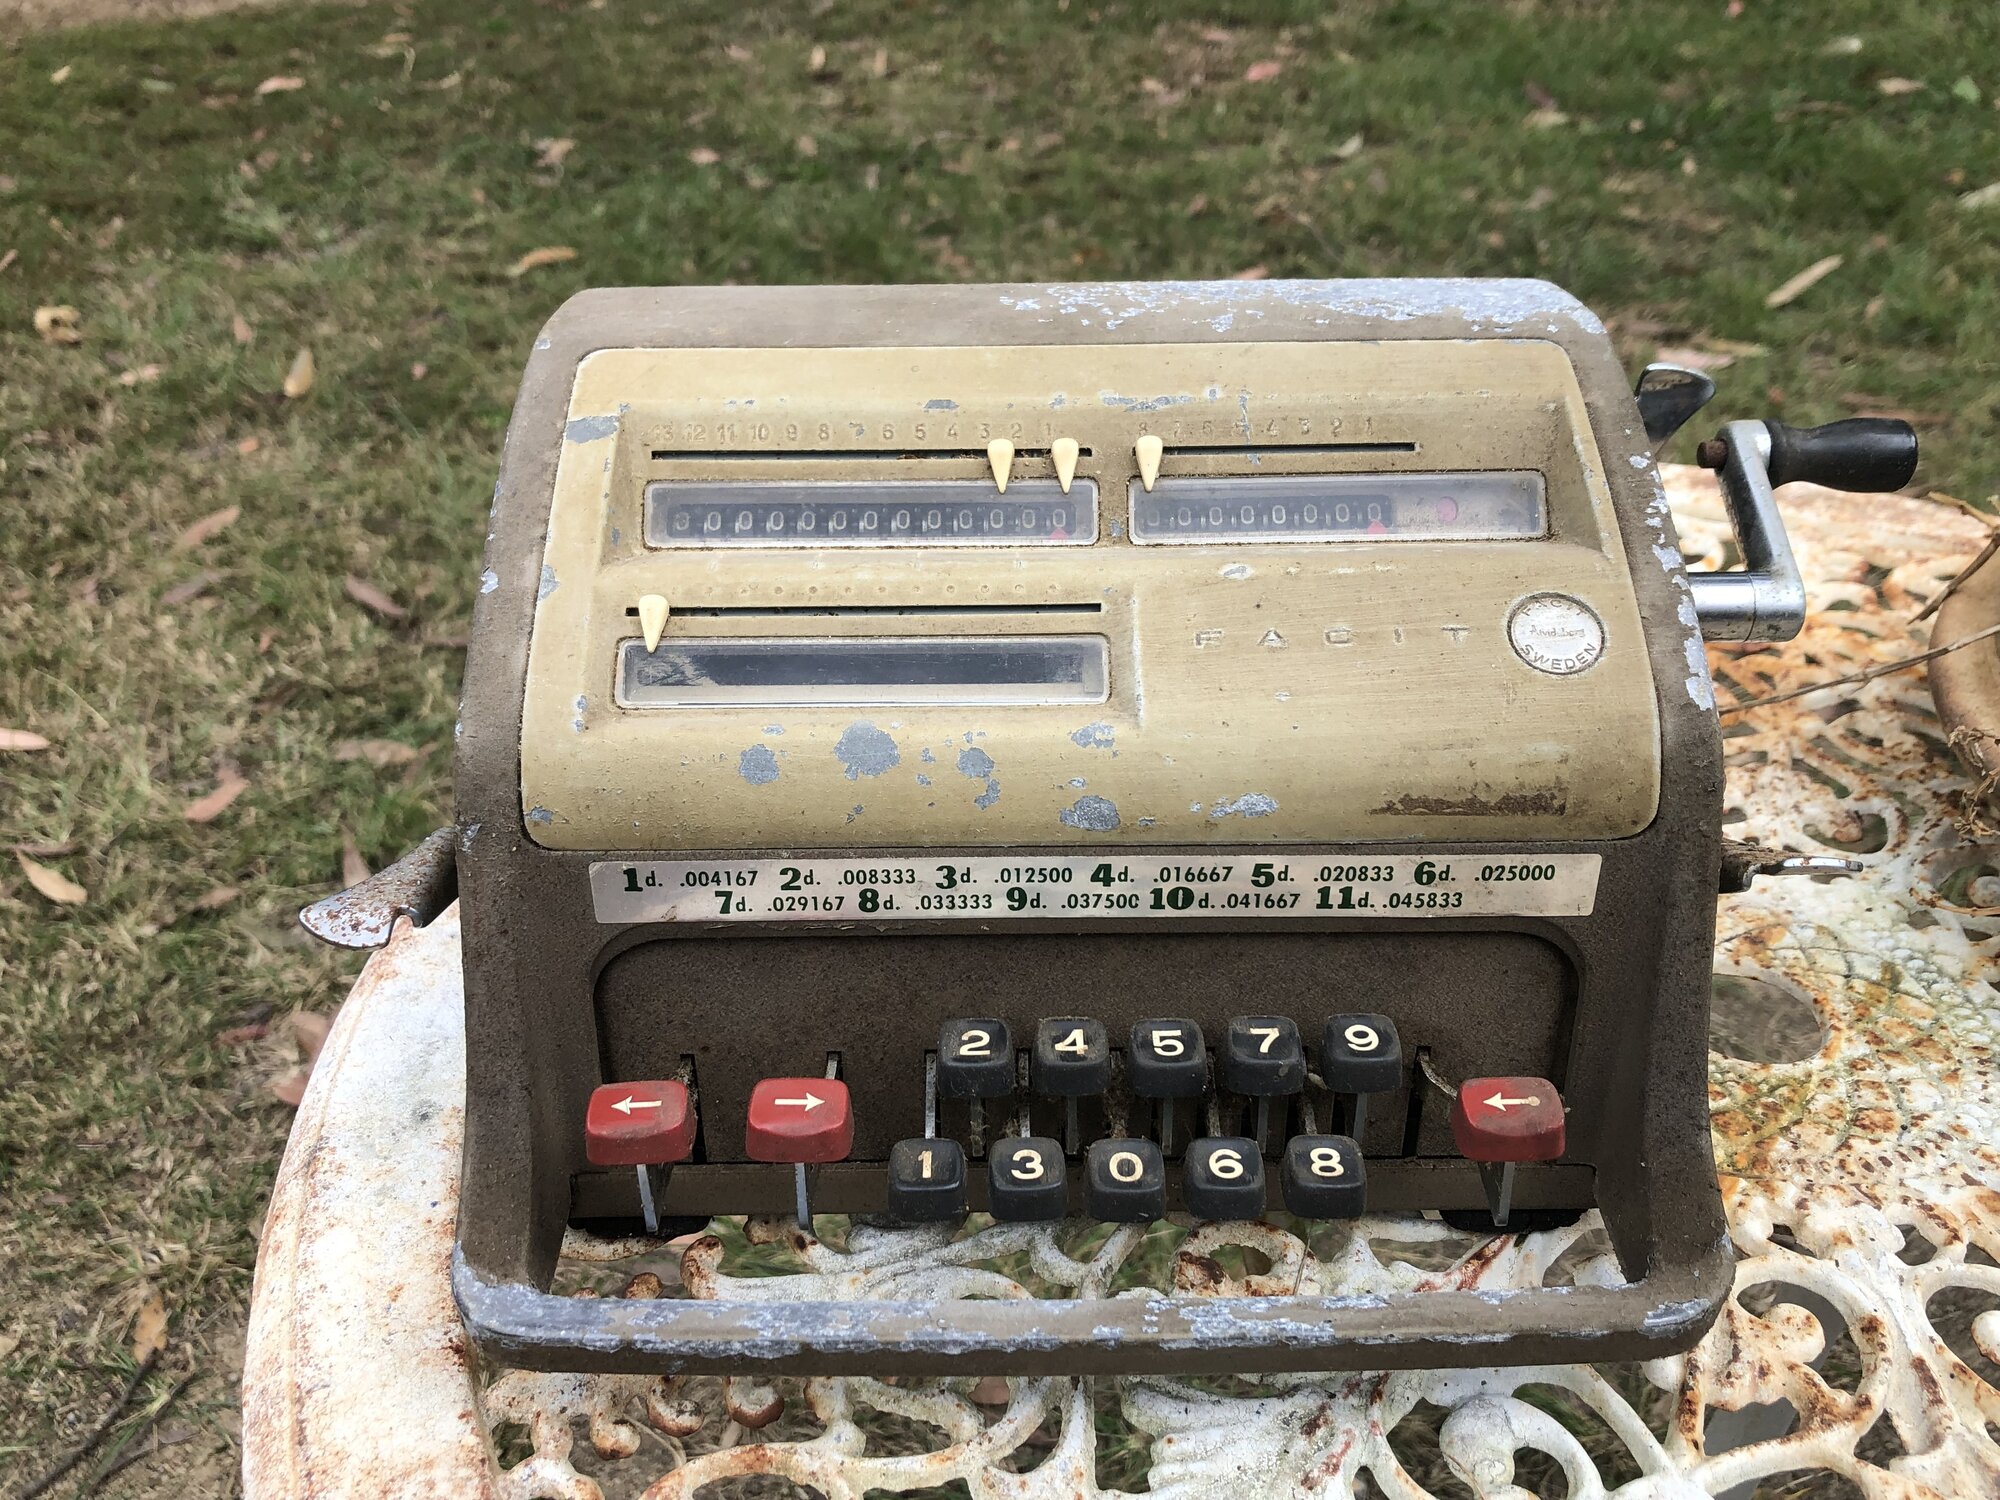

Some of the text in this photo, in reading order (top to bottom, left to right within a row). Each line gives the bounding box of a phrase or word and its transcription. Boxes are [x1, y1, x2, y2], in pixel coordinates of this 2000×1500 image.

[1520, 643, 1597, 671] SWEDEN
[622, 860, 1556, 893] 1d. .004167 2d. .008333 3d. .012500 4d. .016667 5d. .020833 6d. .025000
[766, 895, 846, 913] .029167
[913, 893, 993, 911] .033333
[1219, 892, 1301, 909] .041667
[1381, 891, 1463, 909] .045833
[958, 1024, 1380, 1057] 2 4 5 7 9
[917, 1147, 1345, 1182] 1 3 0 6 8
